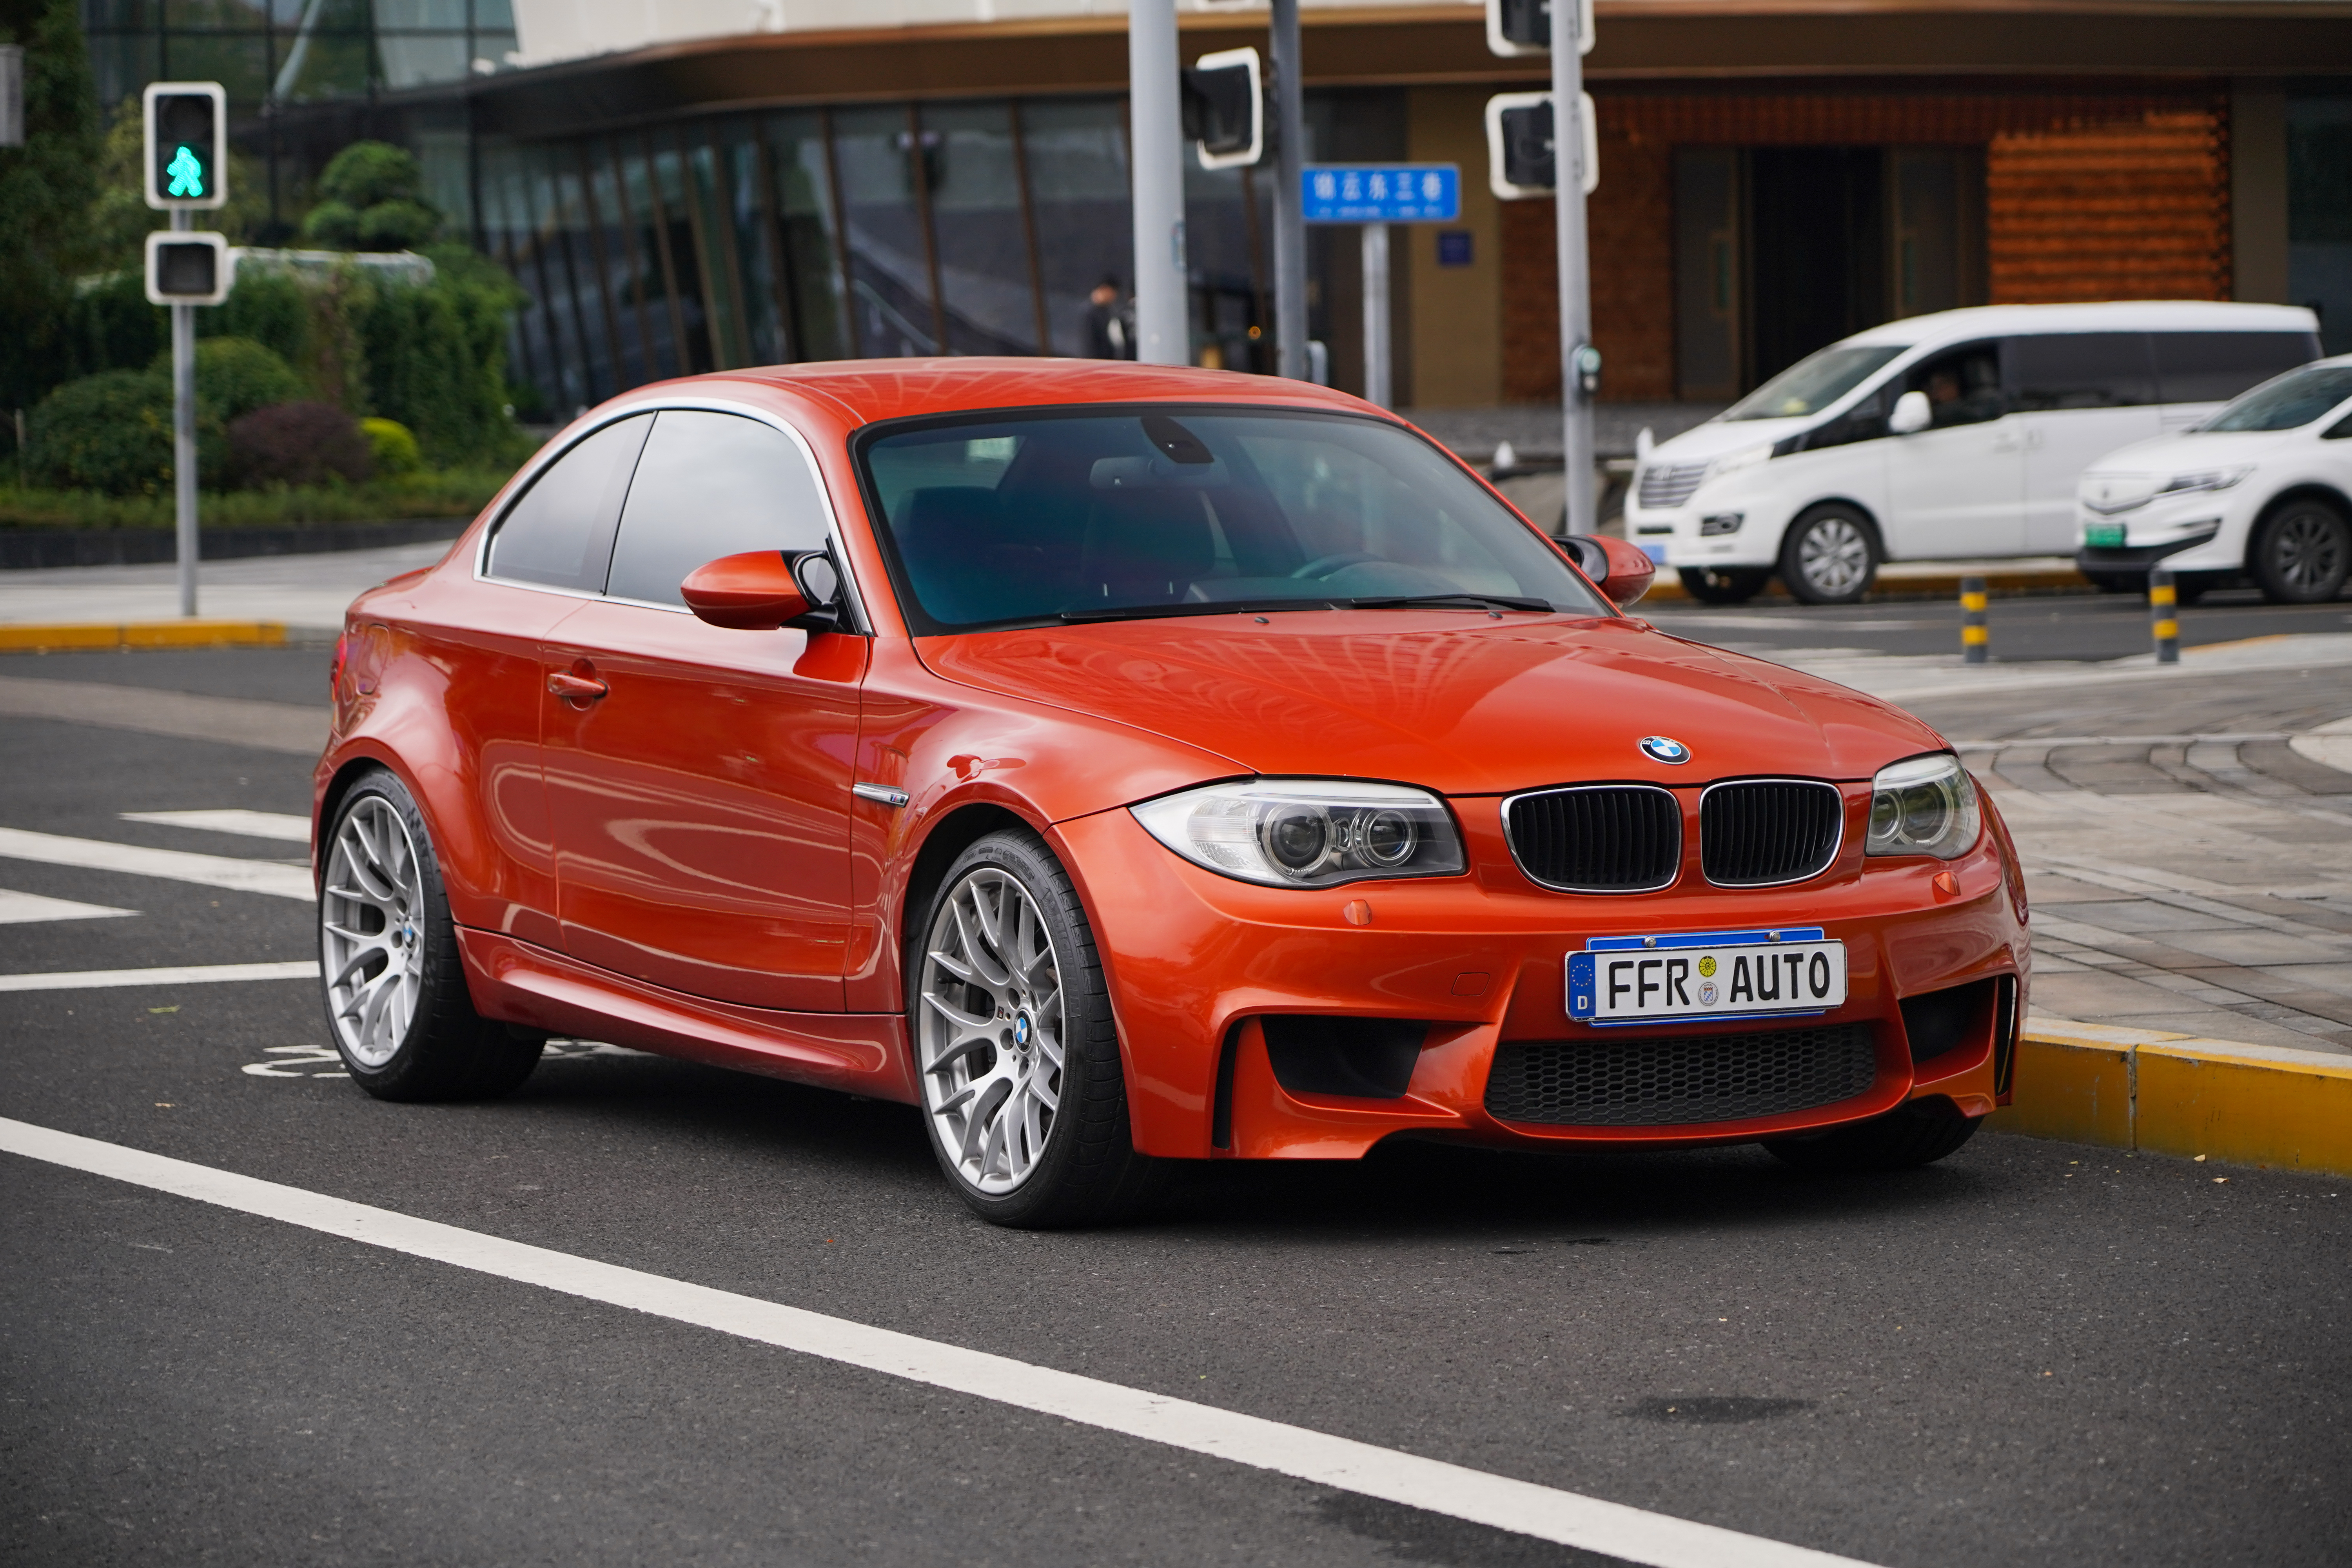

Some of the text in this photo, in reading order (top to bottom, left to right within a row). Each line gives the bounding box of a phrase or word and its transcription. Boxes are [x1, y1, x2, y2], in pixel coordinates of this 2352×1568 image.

[1609, 951, 1830, 1009] FFR AUTO
[1578, 996, 1588, 1009] D
